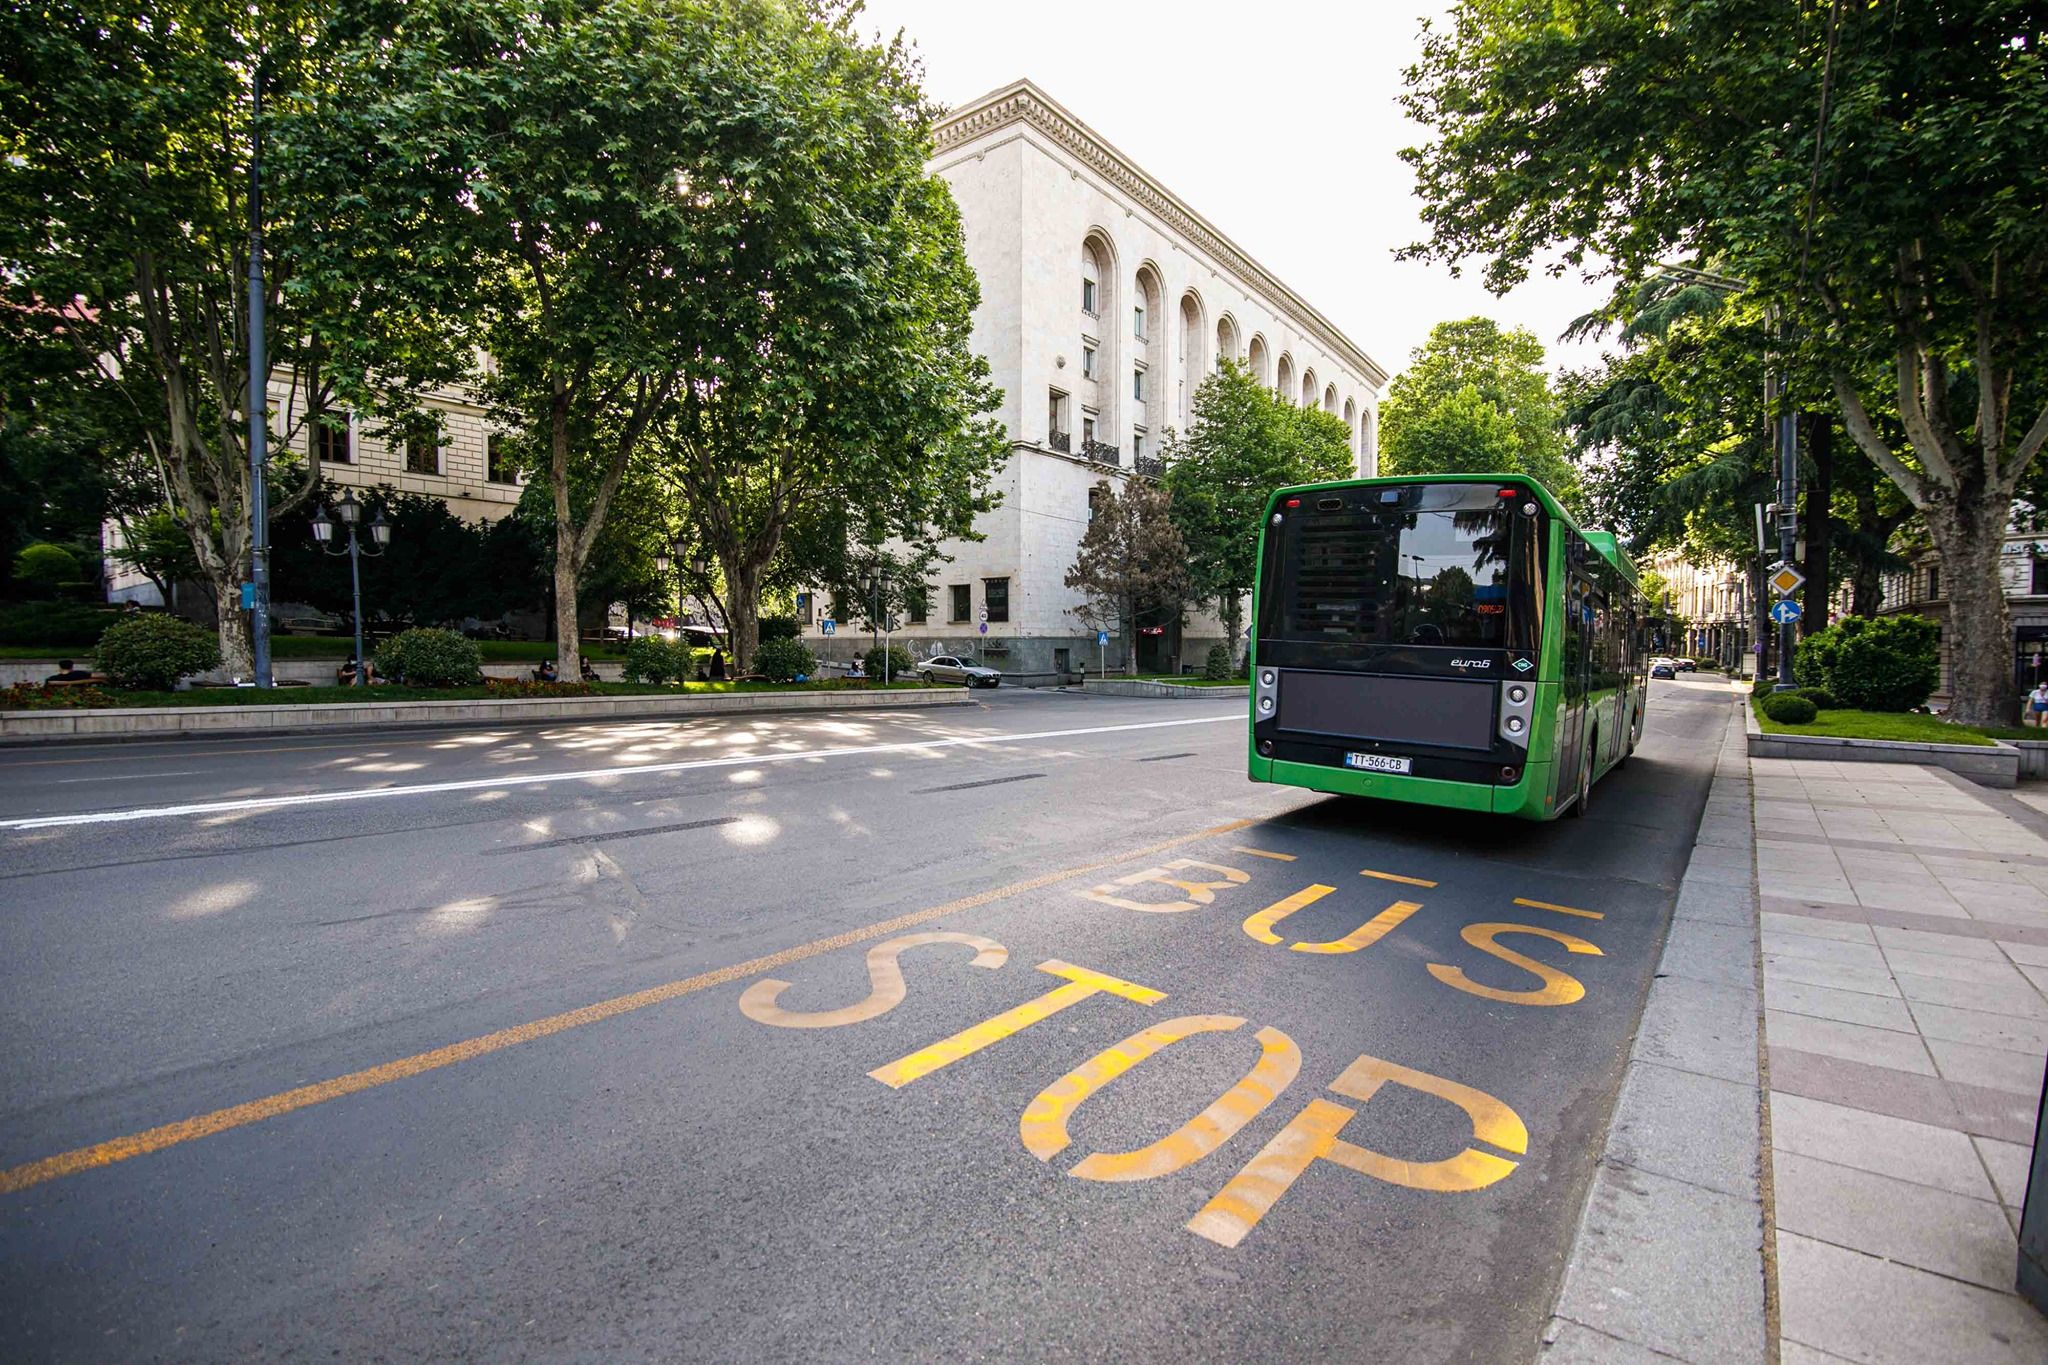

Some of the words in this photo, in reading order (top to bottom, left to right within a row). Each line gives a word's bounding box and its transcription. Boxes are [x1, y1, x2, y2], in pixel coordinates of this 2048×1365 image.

[1450, 659, 1491, 668] euro6
[1354, 754, 1402, 770] TT-566-CB
[1076, 858, 1605, 1006] BUS
[738, 931, 1529, 1248] STOP
